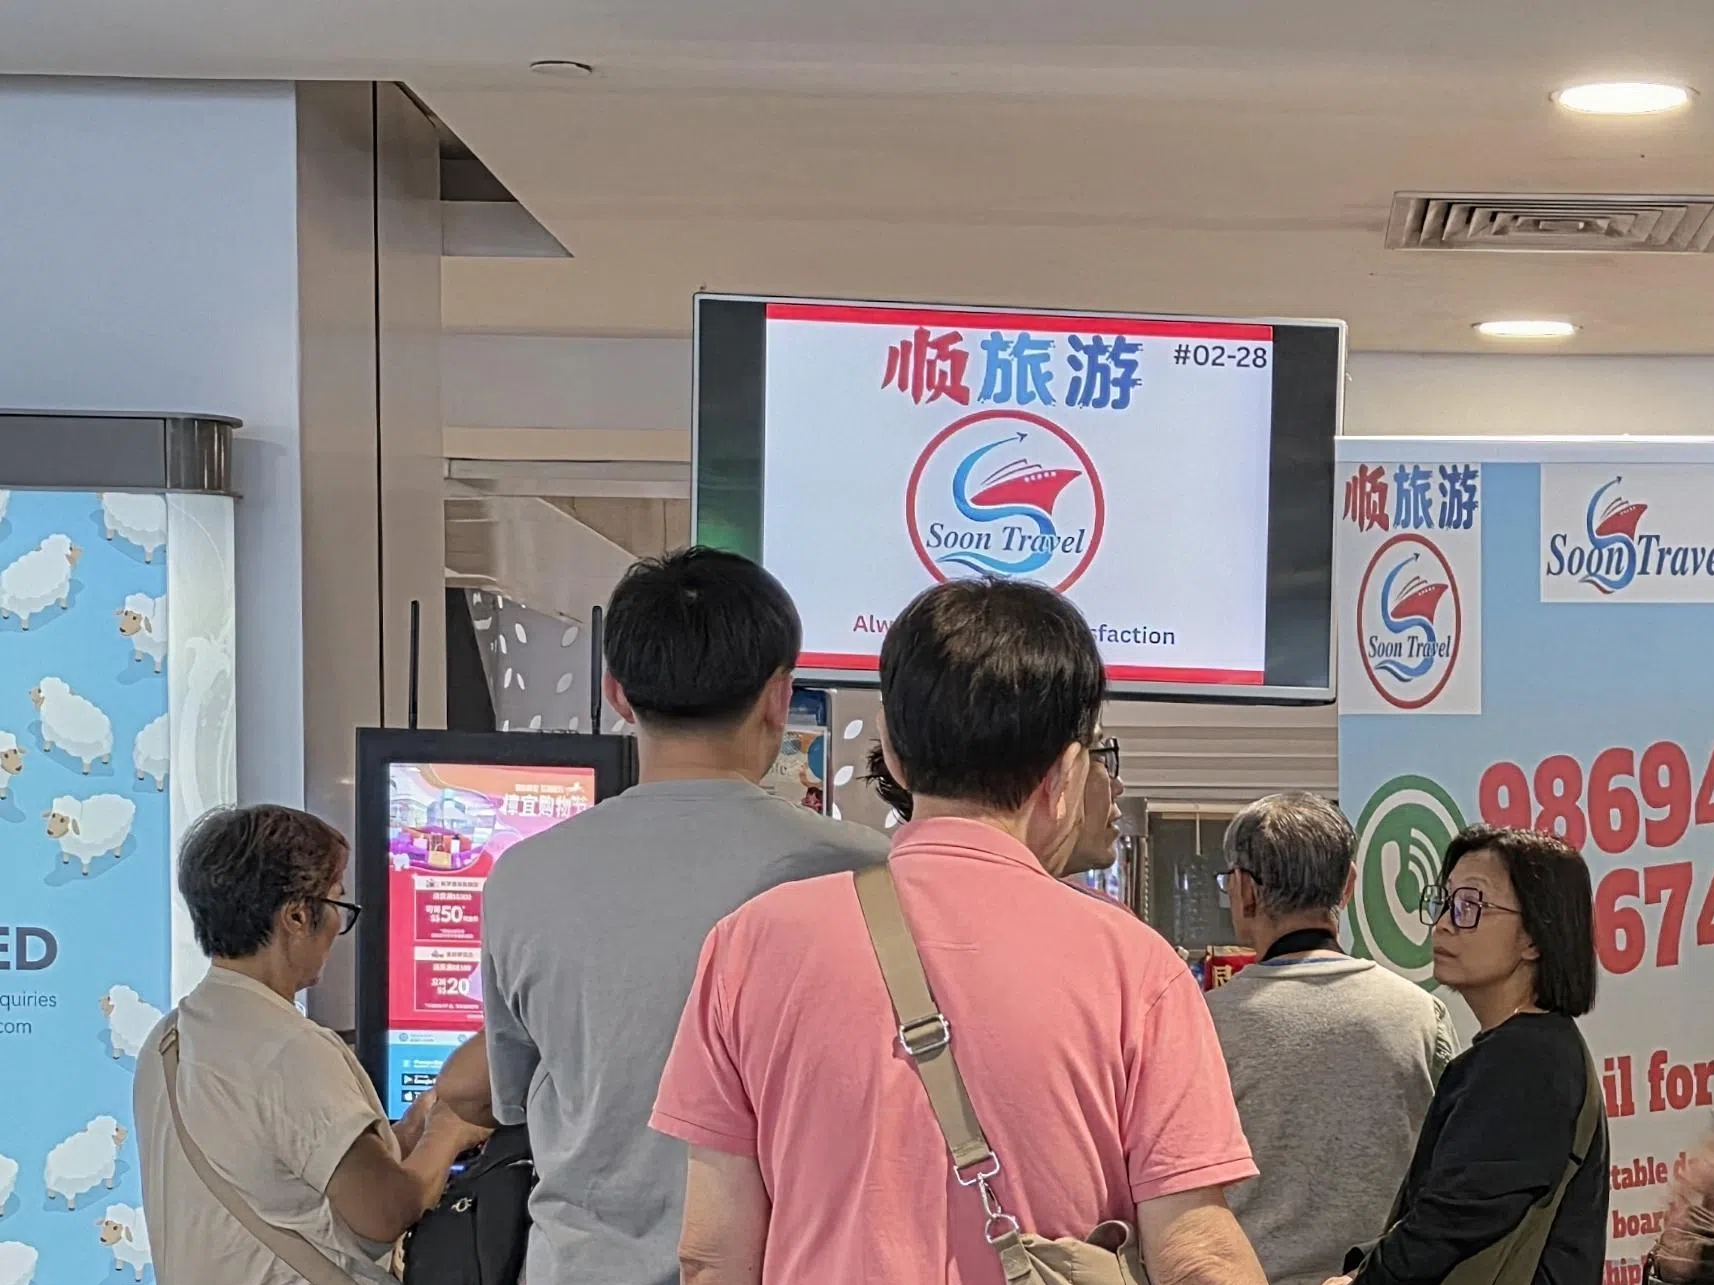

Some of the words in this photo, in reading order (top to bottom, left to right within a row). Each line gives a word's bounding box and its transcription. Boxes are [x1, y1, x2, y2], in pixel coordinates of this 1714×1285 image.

[881, 327, 1143, 409] 顺旅游
[1173, 343, 1268, 368] #02-28
[1343, 463, 1479, 532] 顺旅游
[926, 523, 991, 549] Soon
[1002, 526, 1086, 553] Travel
[1547, 533, 1625, 576] Soon
[853, 614, 893, 633] Alw
[1369, 635, 1402, 658] Soon
[1408, 635, 1451, 658] Travel
[0, 990, 57, 1012] quiries
[1603, 1056, 1635, 1117] il
[1609, 1156, 1668, 1190] table
[1612, 1209, 1665, 1239] boar
